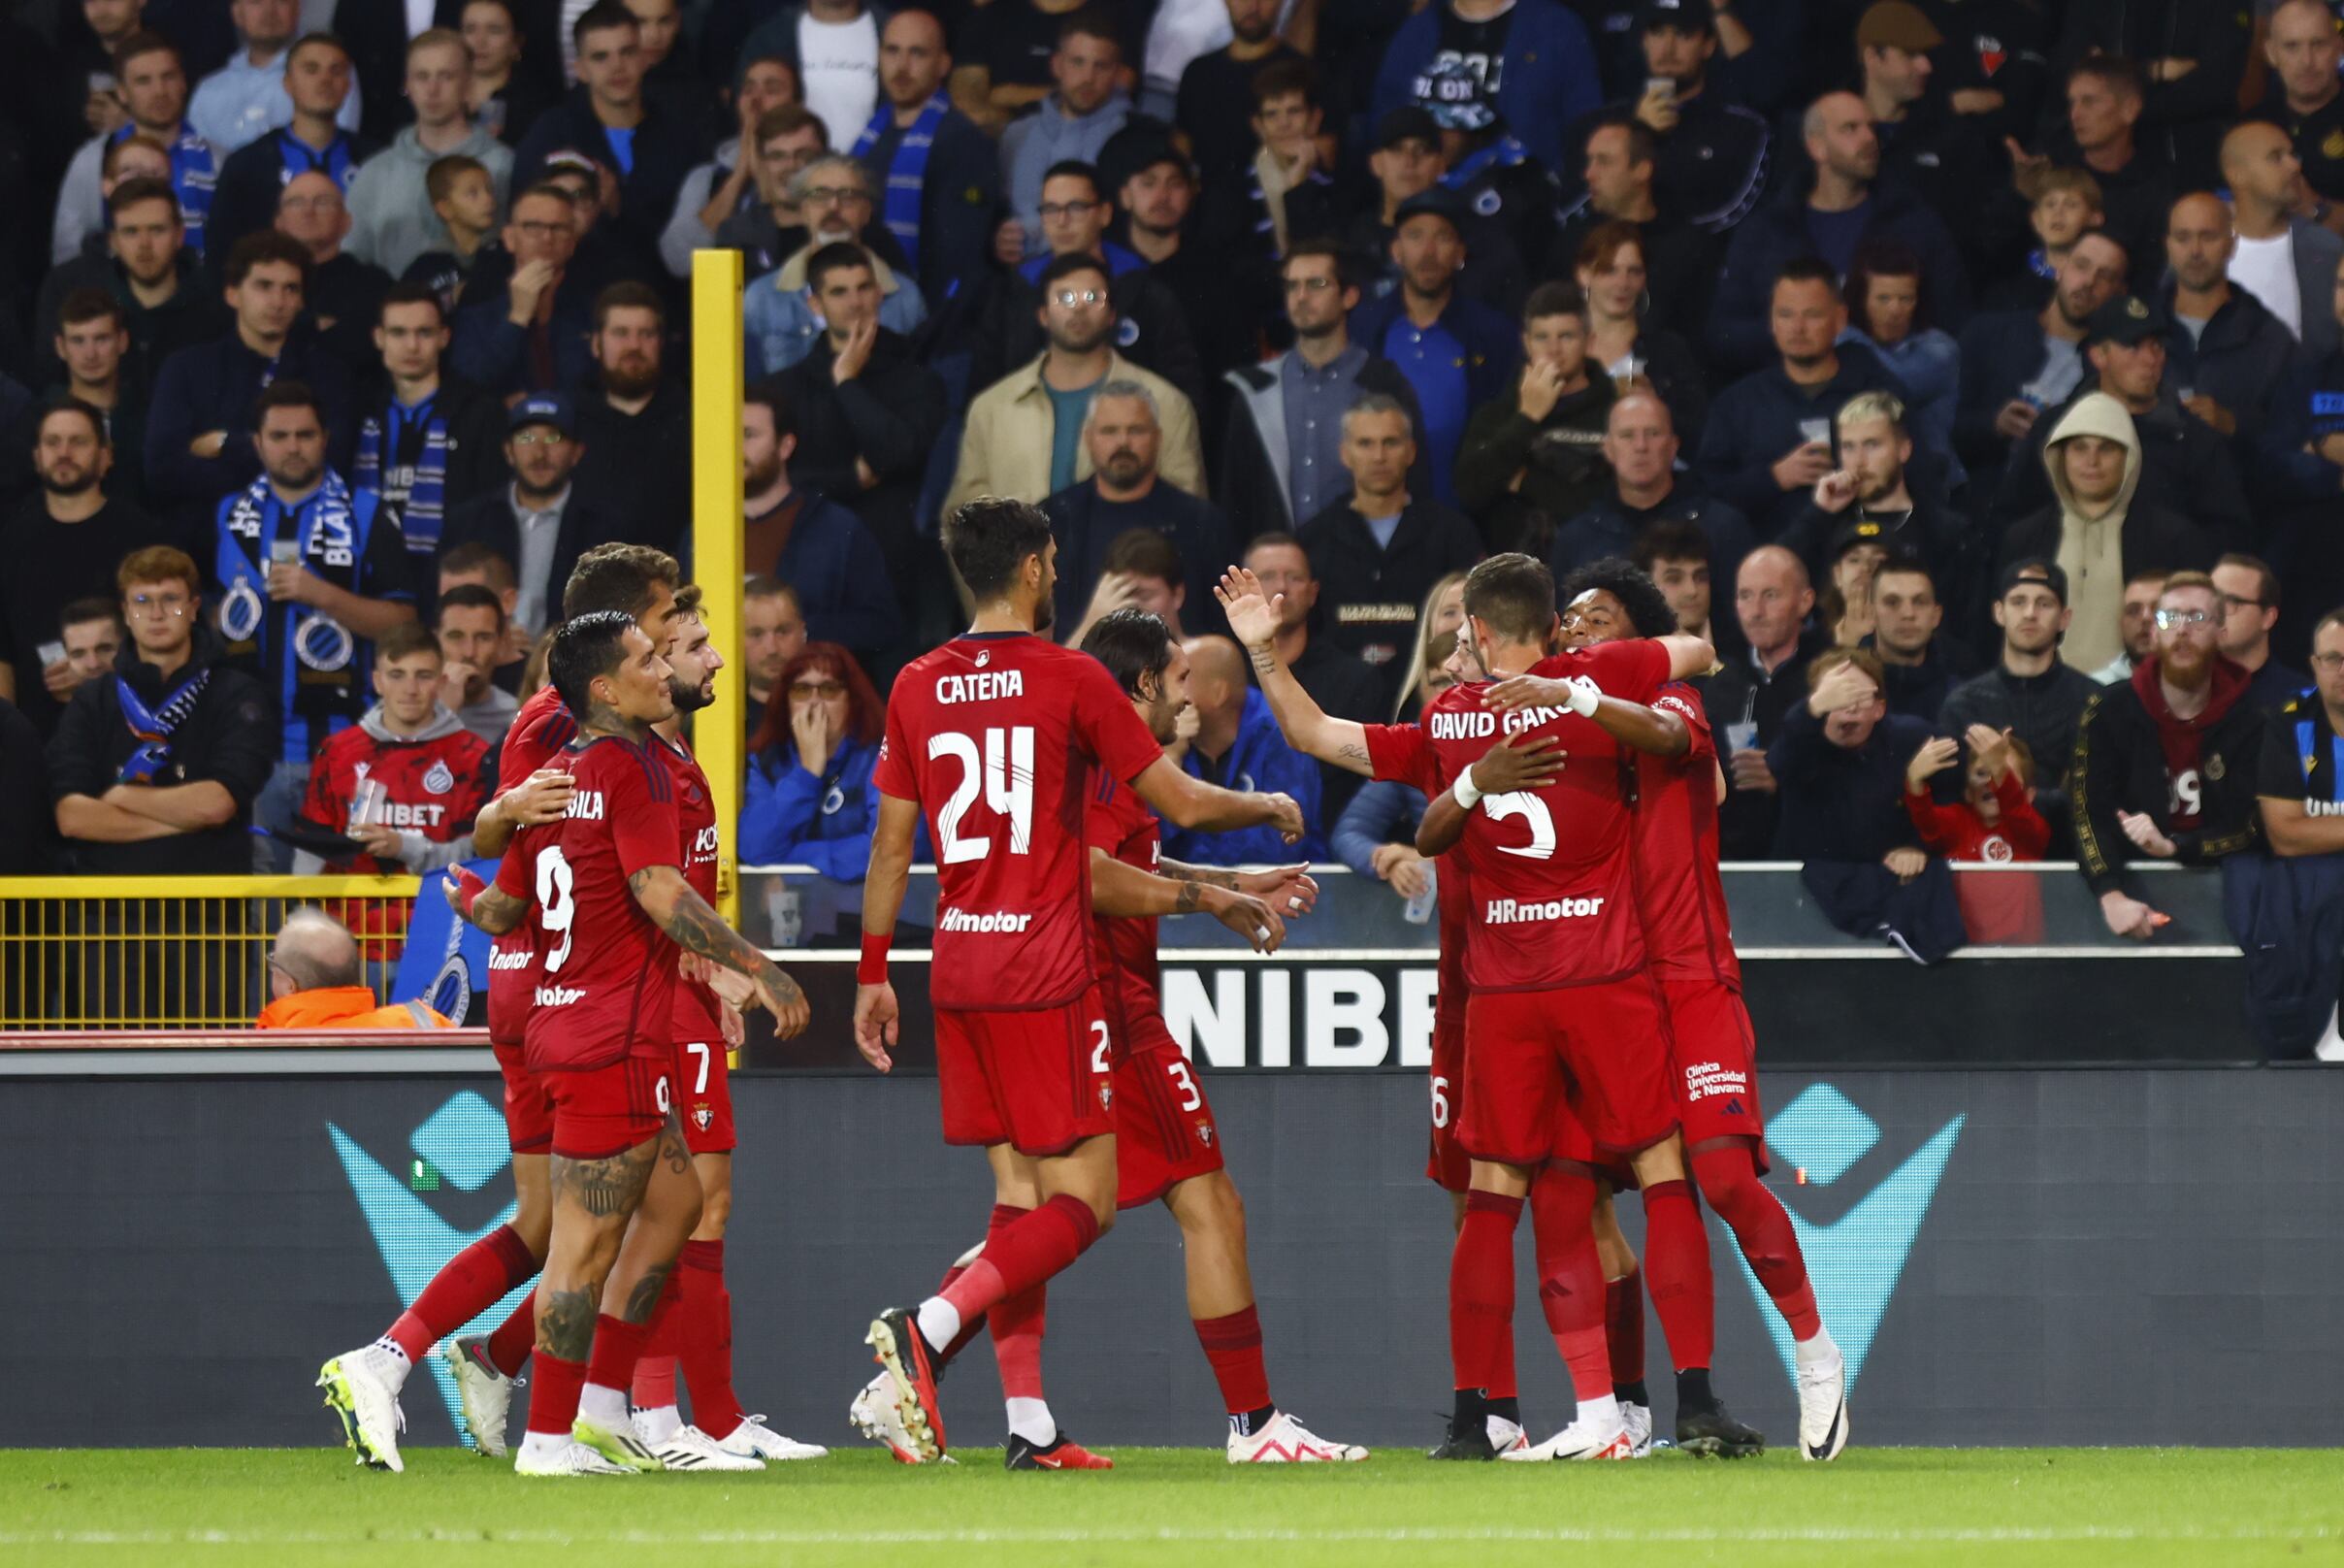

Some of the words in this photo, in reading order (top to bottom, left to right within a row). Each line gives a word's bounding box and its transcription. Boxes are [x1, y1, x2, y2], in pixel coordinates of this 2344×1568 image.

[936, 670, 1023, 704] CATENA
[1431, 712, 1495, 739] DAVID
[563, 790, 603, 820] VILA
[928, 726, 1034, 865] 24
[537, 845, 574, 973] 9
[1485, 898, 1604, 924] HRmotor
[687, 1043, 709, 1094] 7
[1687, 1070, 1746, 1090] Universidad
[1168, 1062, 1202, 1112] 3
[1689, 1089, 1703, 1101] de
[1703, 1084, 1745, 1096] Navarra
